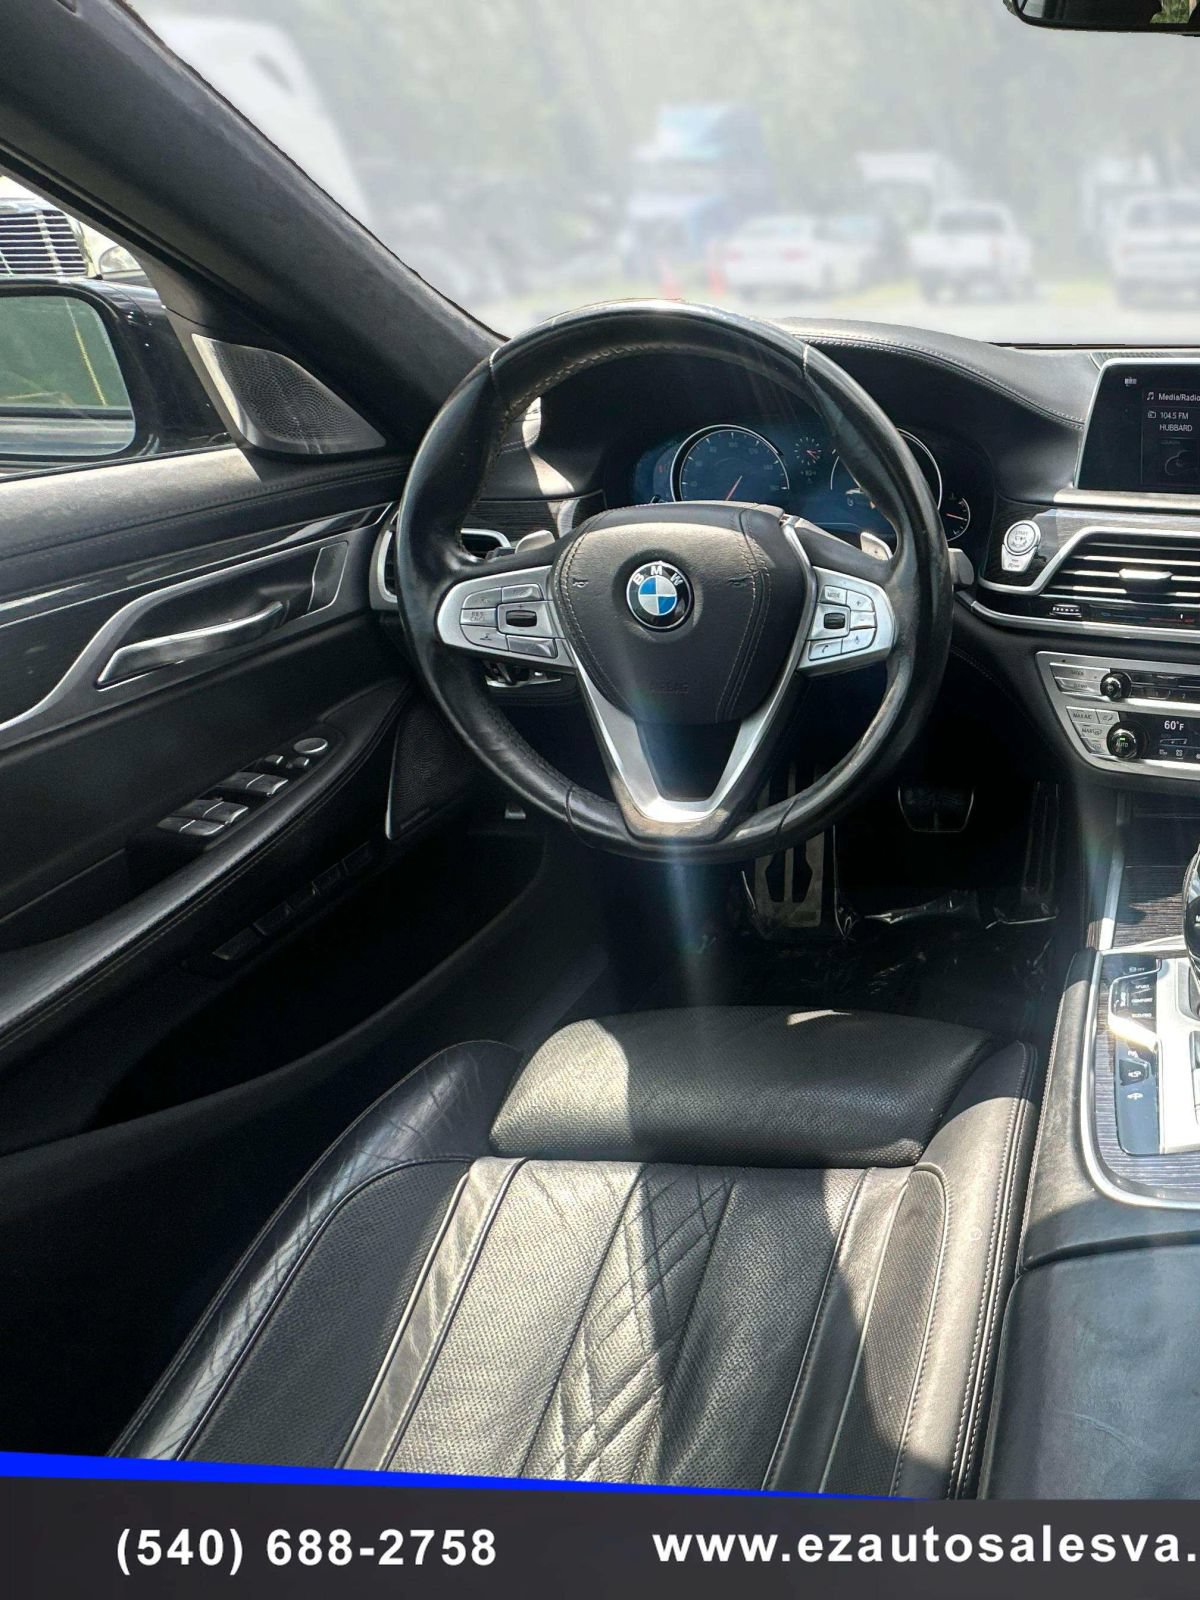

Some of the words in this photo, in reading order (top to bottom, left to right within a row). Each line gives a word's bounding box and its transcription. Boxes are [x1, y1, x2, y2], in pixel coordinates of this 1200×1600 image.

[1158, 393, 1200, 402] Media/Radio
[1160, 412, 1177, 420] 104.5
[1178, 412, 1189, 420] FM
[1159, 424, 1193, 432] HUBBARD
[632, 565, 683, 586] BMW
[1164, 720, 1185, 731] 60°F
